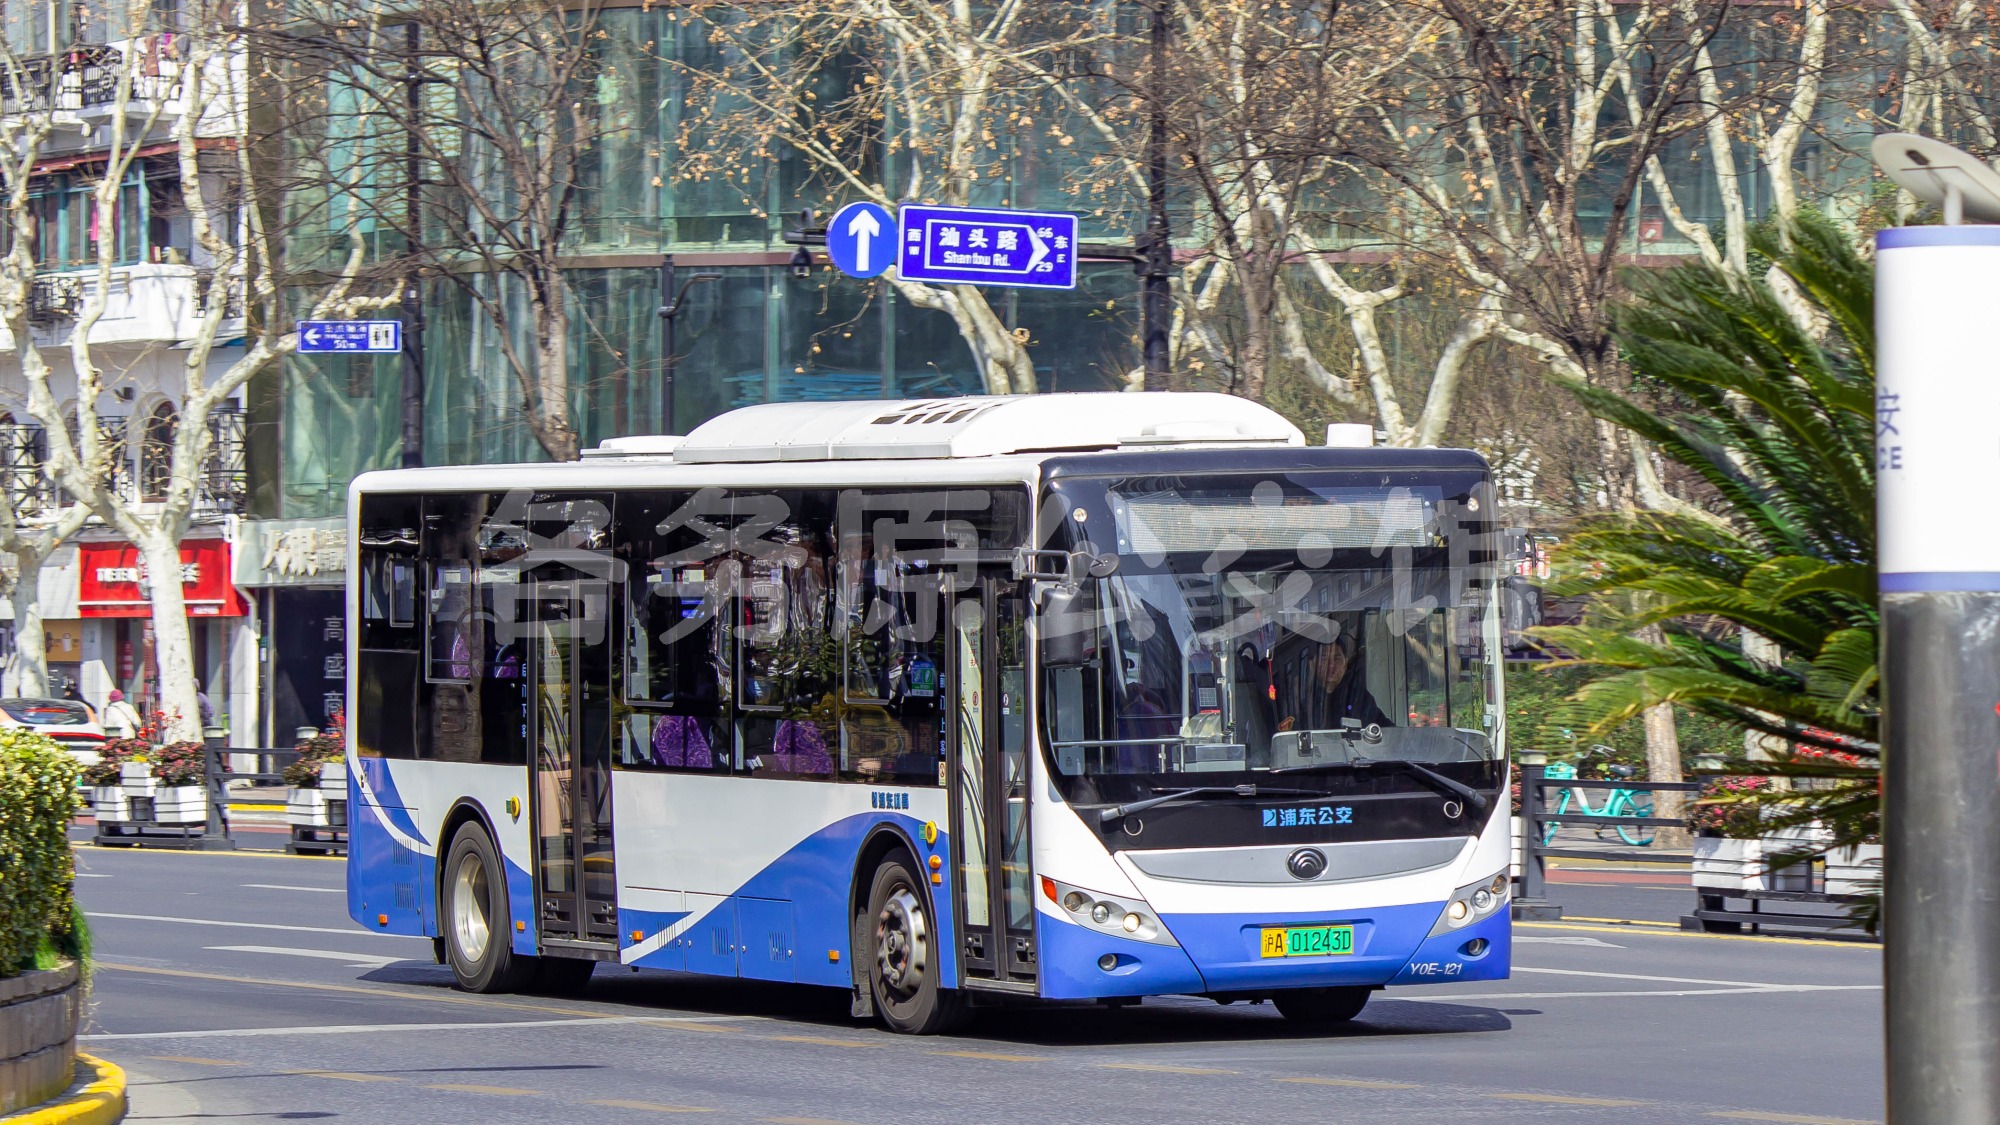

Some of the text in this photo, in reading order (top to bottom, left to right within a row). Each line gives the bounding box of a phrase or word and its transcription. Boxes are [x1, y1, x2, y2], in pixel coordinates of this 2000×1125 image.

[907, 228, 922, 241] 西
[939, 226, 1018, 251] 汕头路
[1054, 235, 1068, 249] 东
[943, 251, 1010, 266] Shantou Rd.
[1056, 254, 1066, 263] E
[1036, 261, 1053, 272] 29
[1279, 806, 1353, 826] 浦东公交
